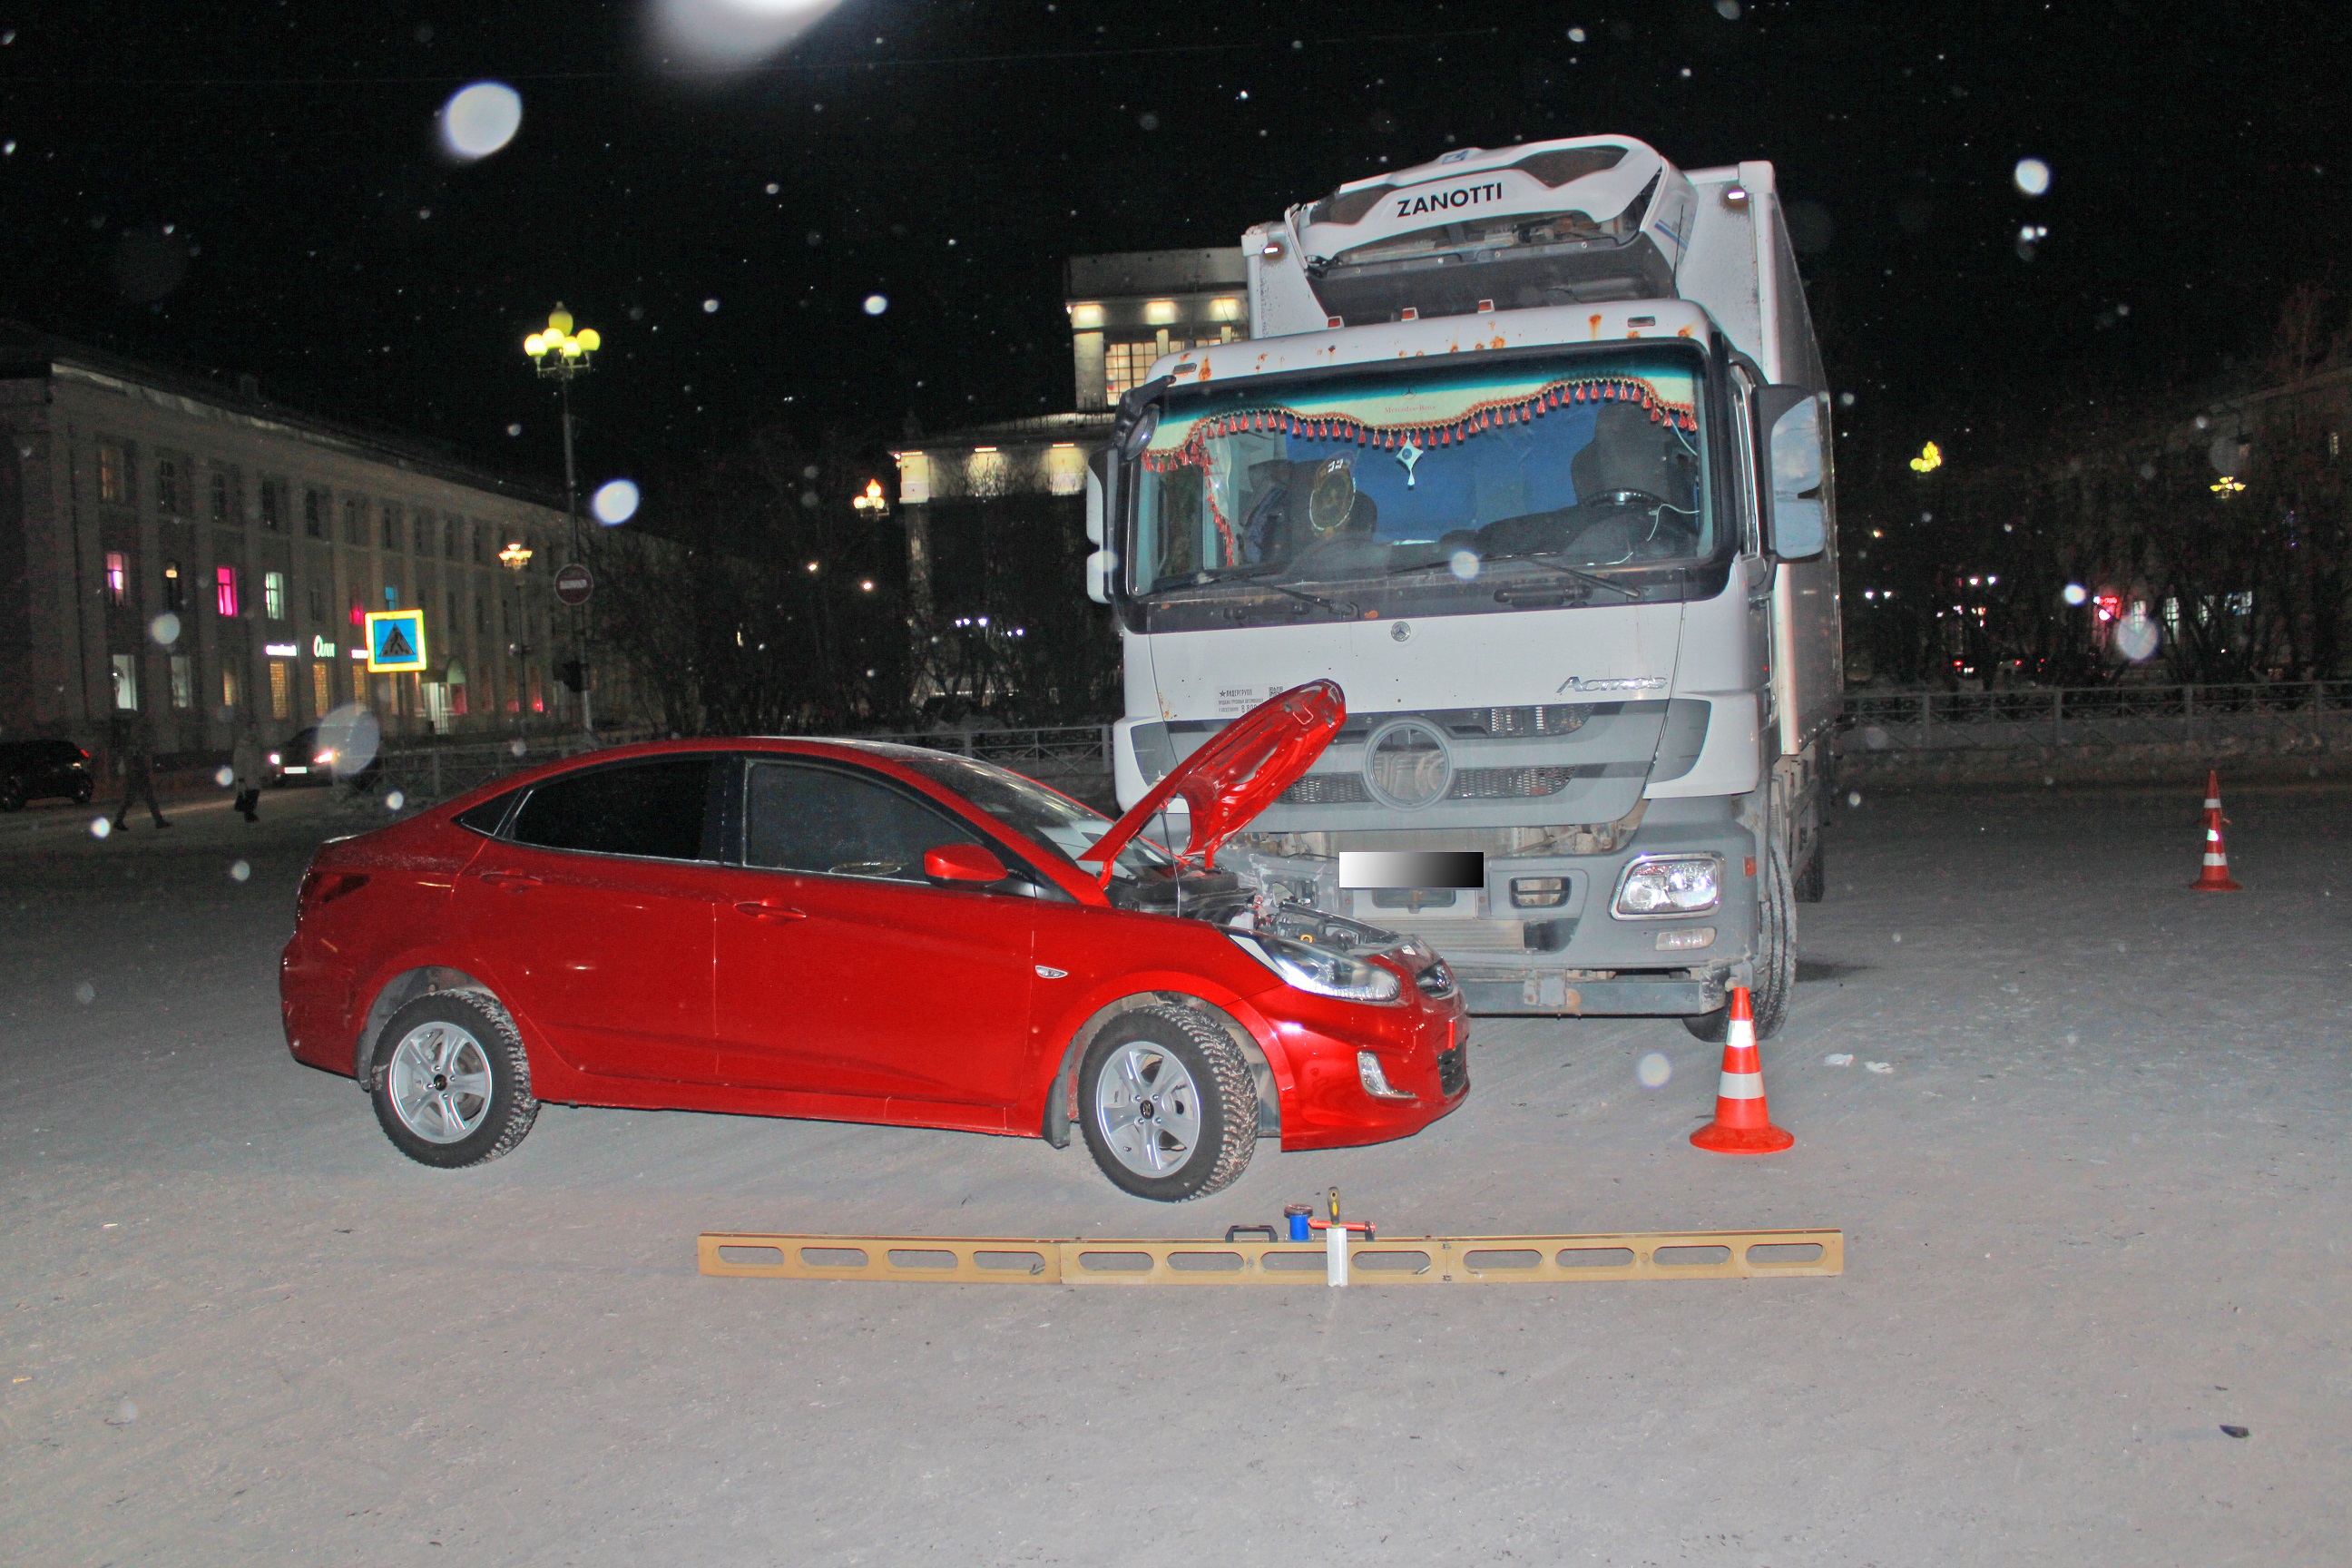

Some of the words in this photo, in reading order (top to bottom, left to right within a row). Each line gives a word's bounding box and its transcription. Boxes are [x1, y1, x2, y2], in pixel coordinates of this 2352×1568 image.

[1396, 181, 1503, 219] ZANOTTI
[1385, 405, 1436, 414] Mercedes-Benz
[1556, 676, 1667, 694] Actros
